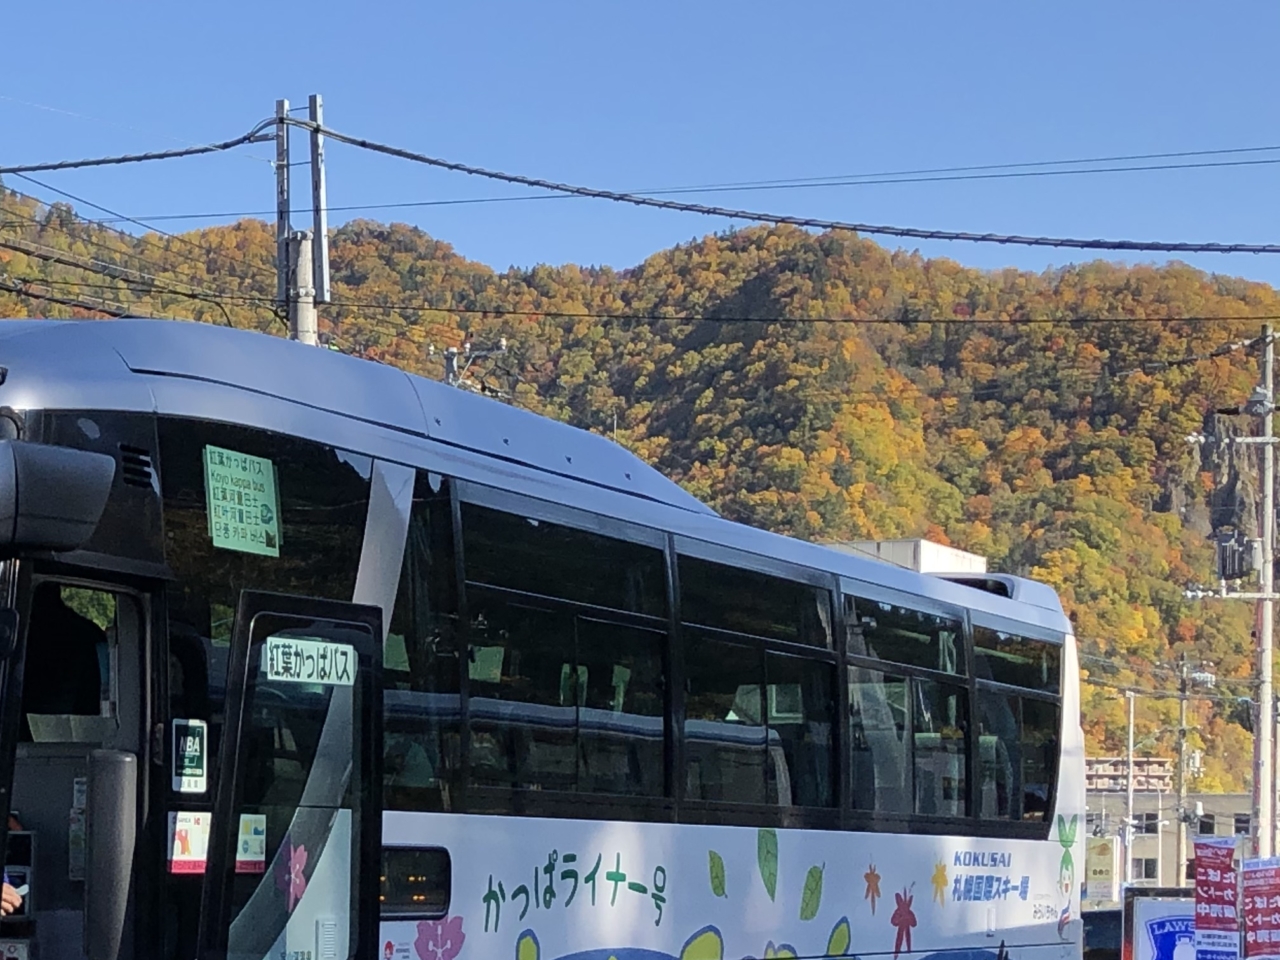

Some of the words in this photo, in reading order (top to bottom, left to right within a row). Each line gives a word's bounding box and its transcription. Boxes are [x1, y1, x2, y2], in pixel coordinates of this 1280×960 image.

[268, 642, 351, 682] 紅葉かっぱバス
[954, 851, 1012, 867] KOKUSAI
[482, 849, 667, 933] かっぱライナー号
[952, 875, 1030, 901] 札幌国際スキー場
[1152, 920, 1195, 935] LAWS
